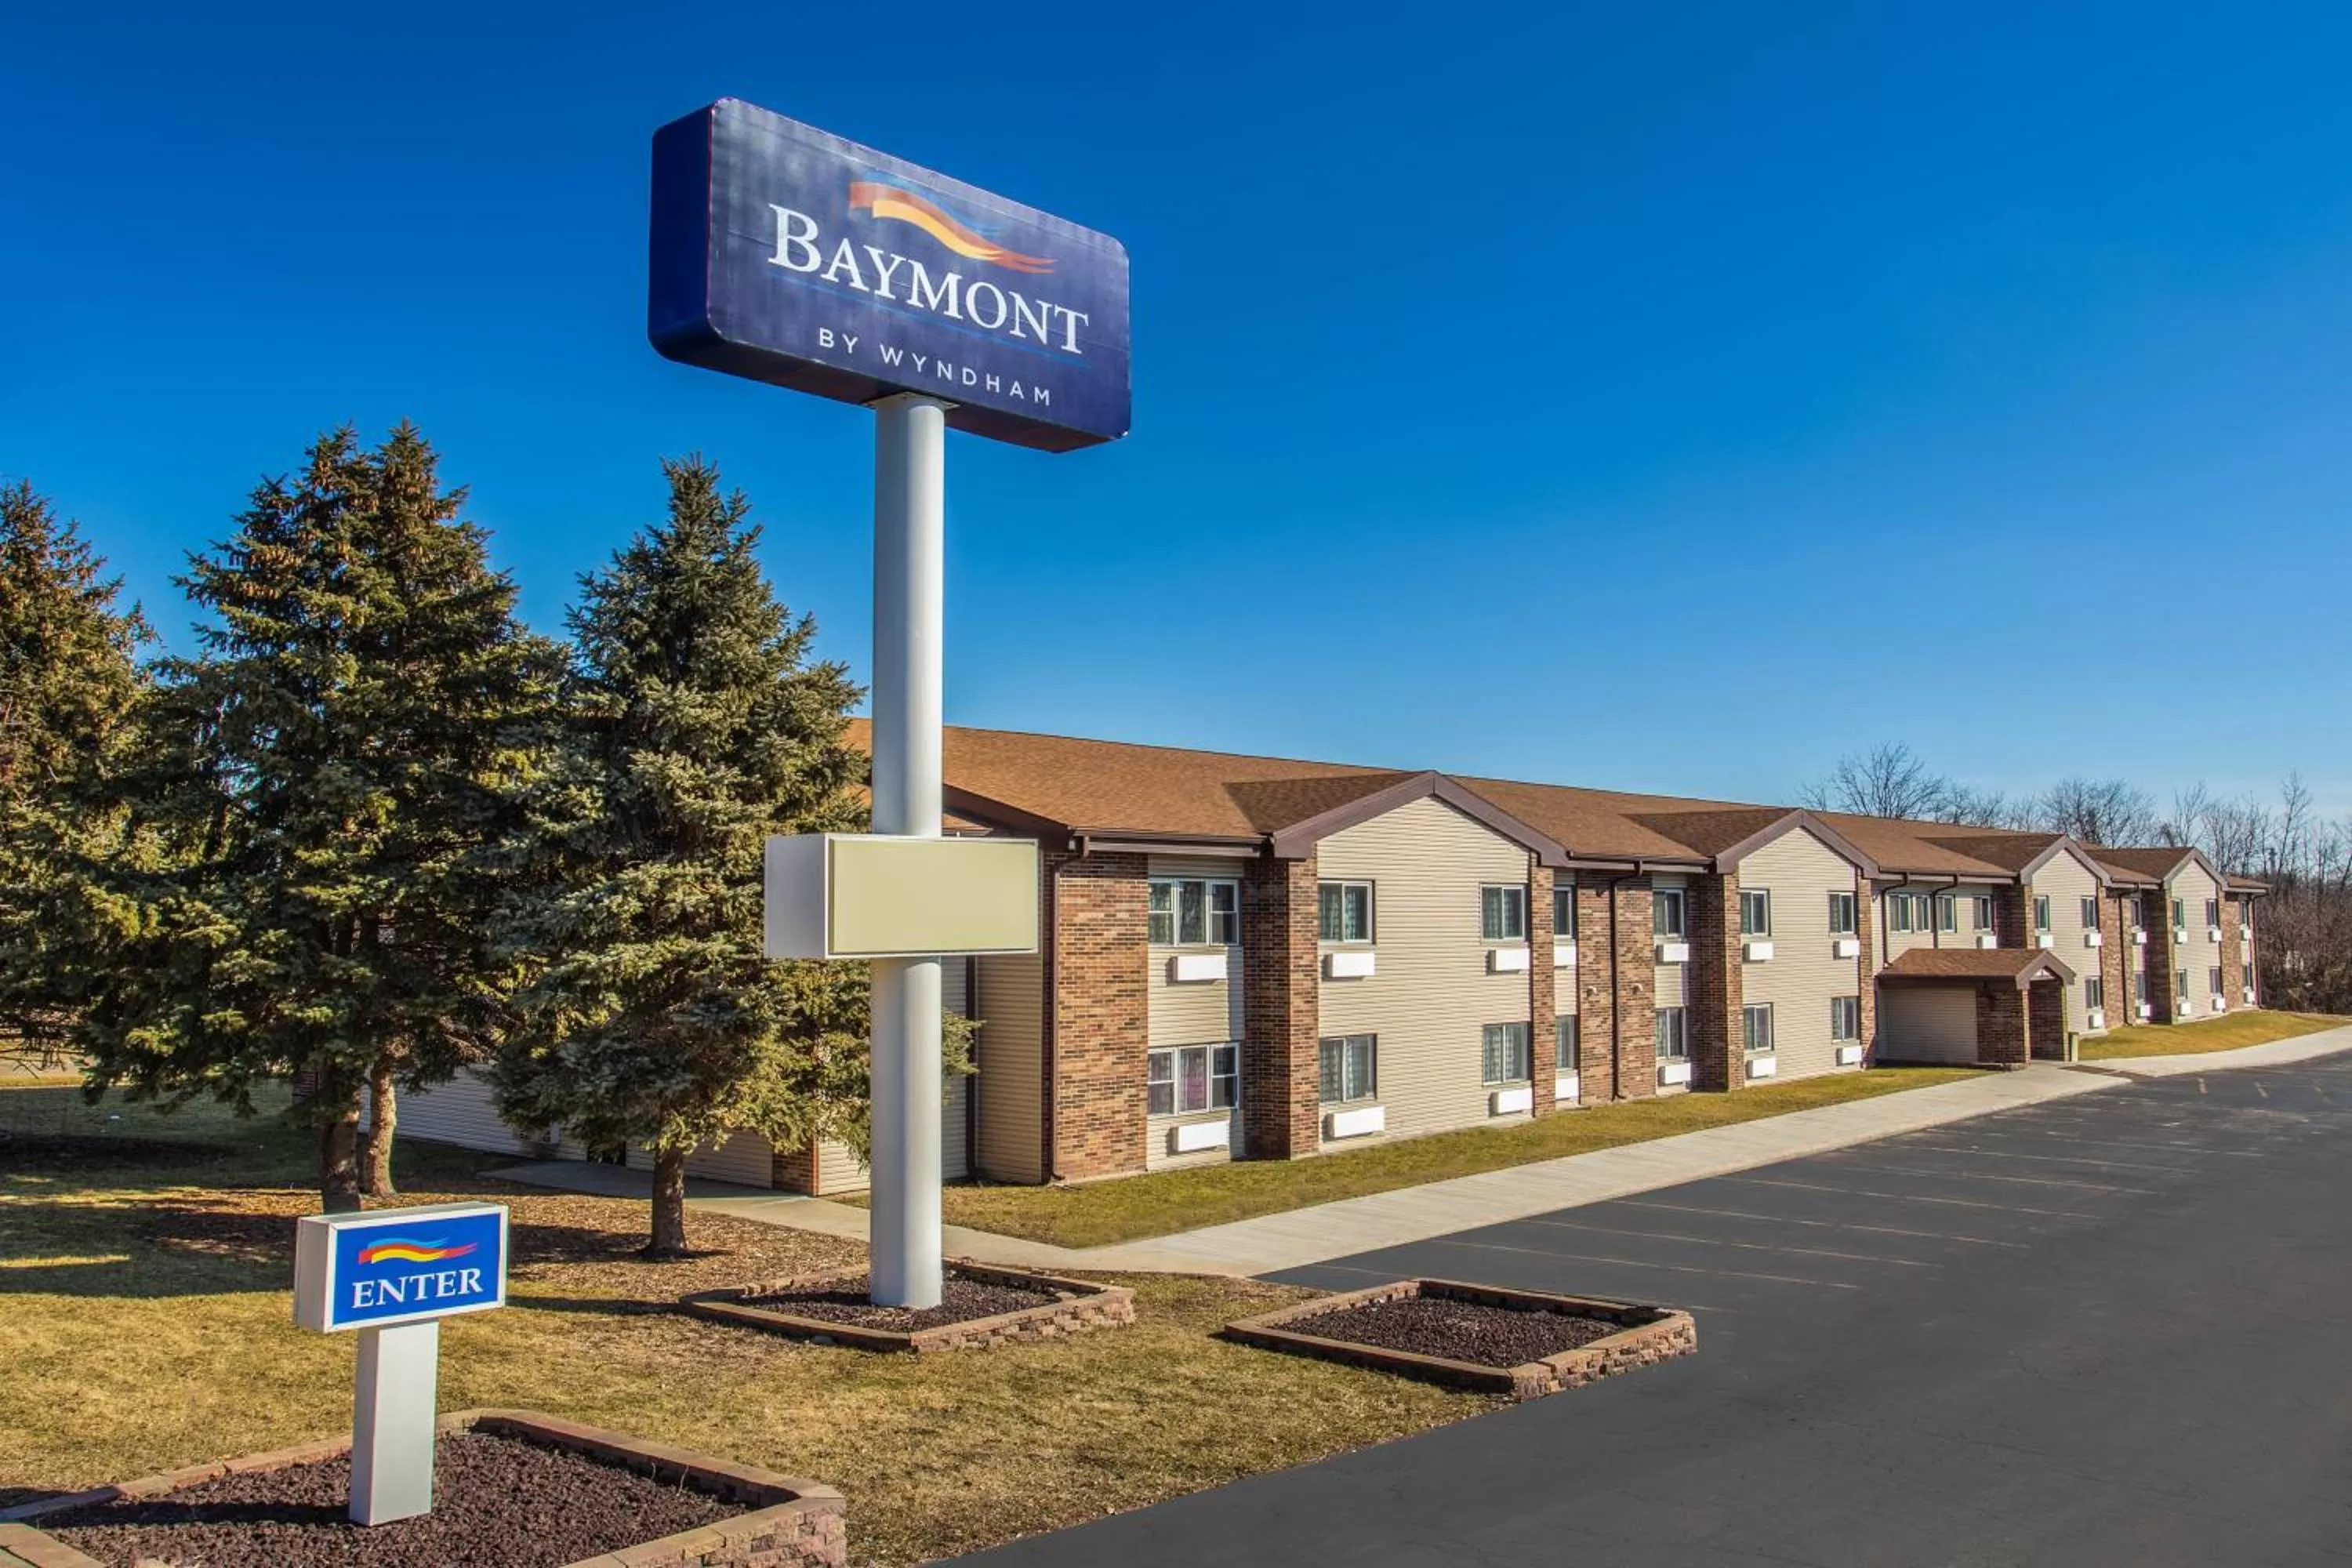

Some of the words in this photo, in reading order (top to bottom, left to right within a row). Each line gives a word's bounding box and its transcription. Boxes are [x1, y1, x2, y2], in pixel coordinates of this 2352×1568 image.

[768, 203, 1090, 355] BAYMONT
[819, 327, 858, 354] BY
[880, 344, 1051, 406] WYNDHAM
[351, 1268, 484, 1309] ENTER
